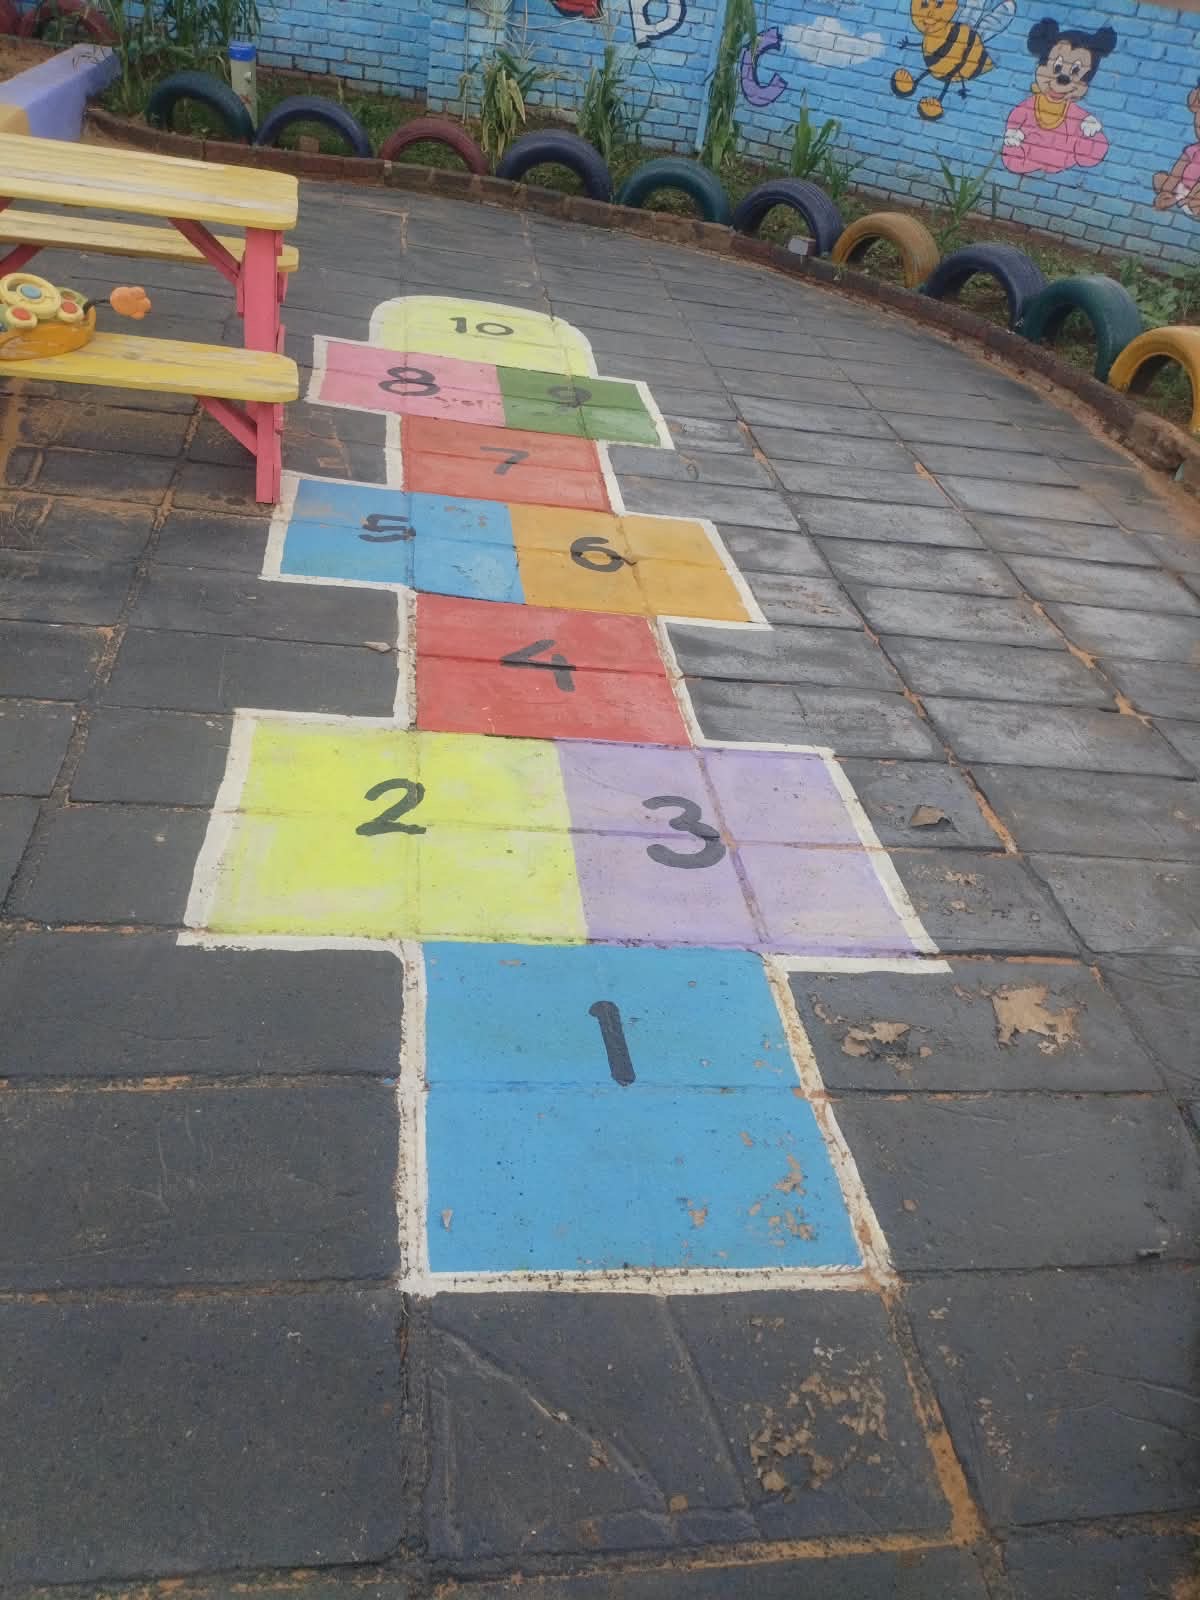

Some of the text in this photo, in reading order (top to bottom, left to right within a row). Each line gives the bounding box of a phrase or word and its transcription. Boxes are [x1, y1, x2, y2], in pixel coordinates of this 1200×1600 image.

[450, 316, 514, 336] 10
[379, 366, 440, 397] 8
[546, 385, 593, 411] 9
[480, 446, 529, 475] 7
[359, 514, 416, 542] 5
[570, 537, 624, 572] 6
[500, 639, 576, 692] 4
[356, 778, 426, 836] 2
[643, 796, 726, 869] 3
[589, 1001, 636, 1087] 1
